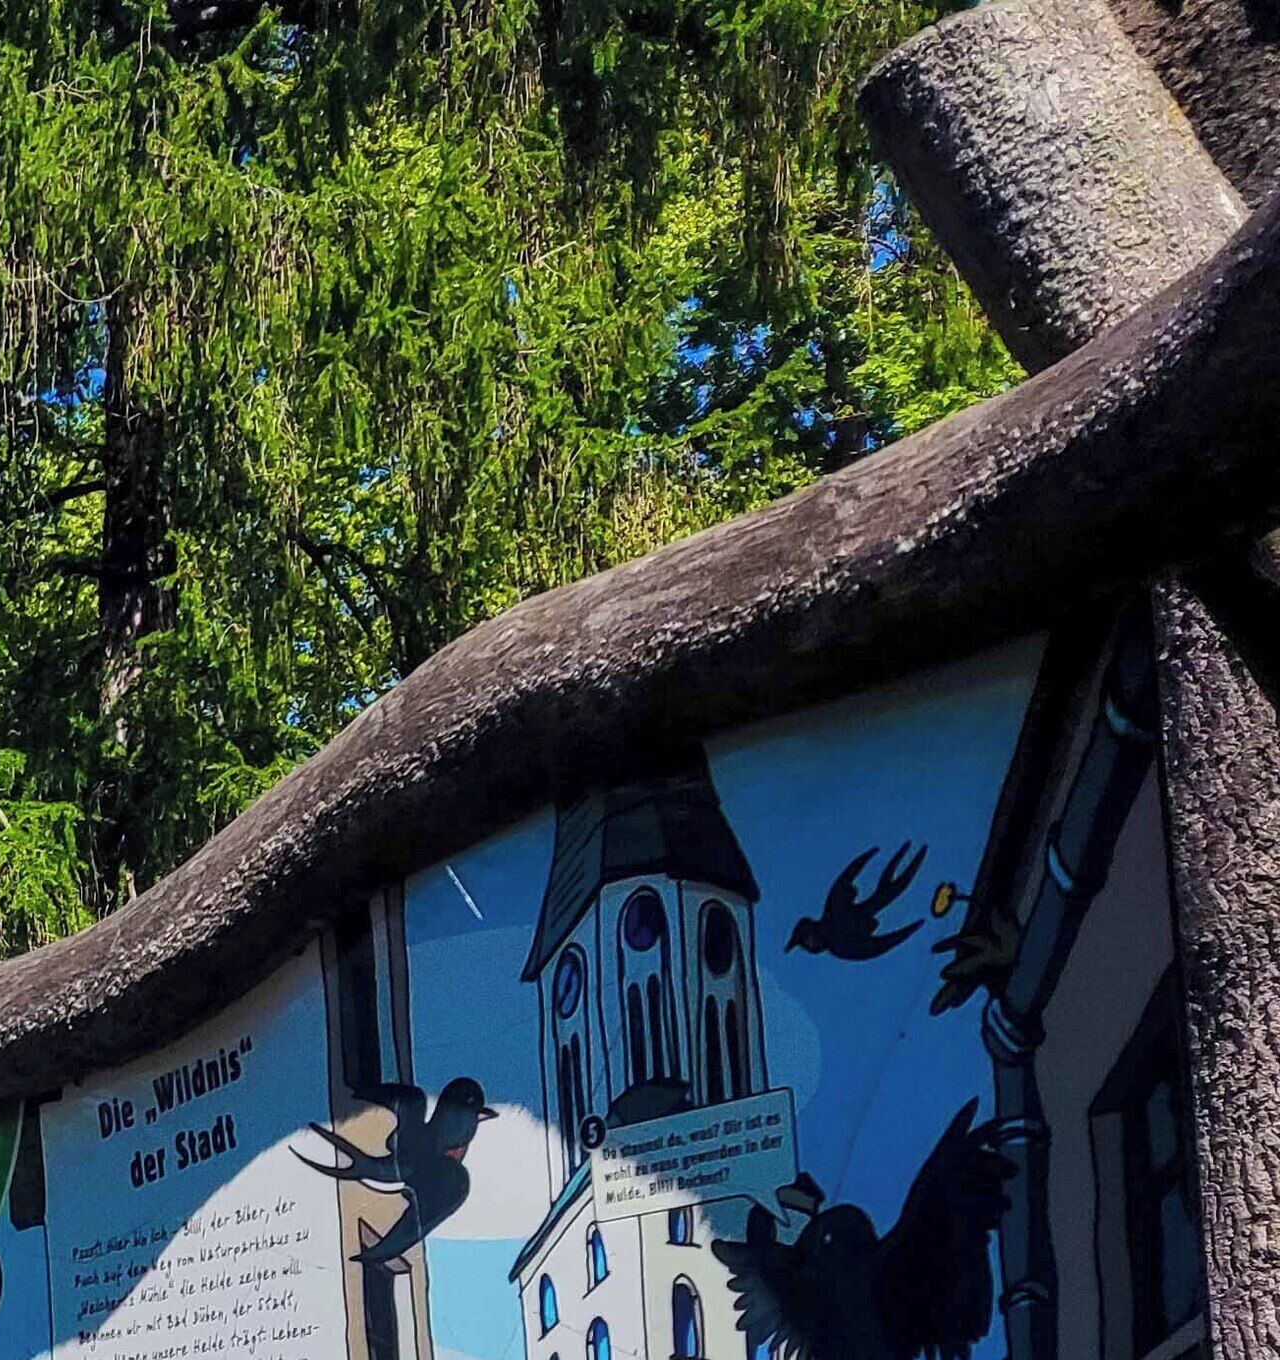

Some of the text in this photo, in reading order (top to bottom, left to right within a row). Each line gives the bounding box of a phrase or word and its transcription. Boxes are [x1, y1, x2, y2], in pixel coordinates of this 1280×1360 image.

[97, 1097, 135, 1139] Die
[130, 1114, 236, 1188] der Stadt
[210, 1196, 296, 1231] der der
[296, 1230, 309, 1242] zu
[167, 1309, 188, 1328] Bad
[233, 1299, 252, 1318] der
[152, 1345, 188, 1360] unsere
